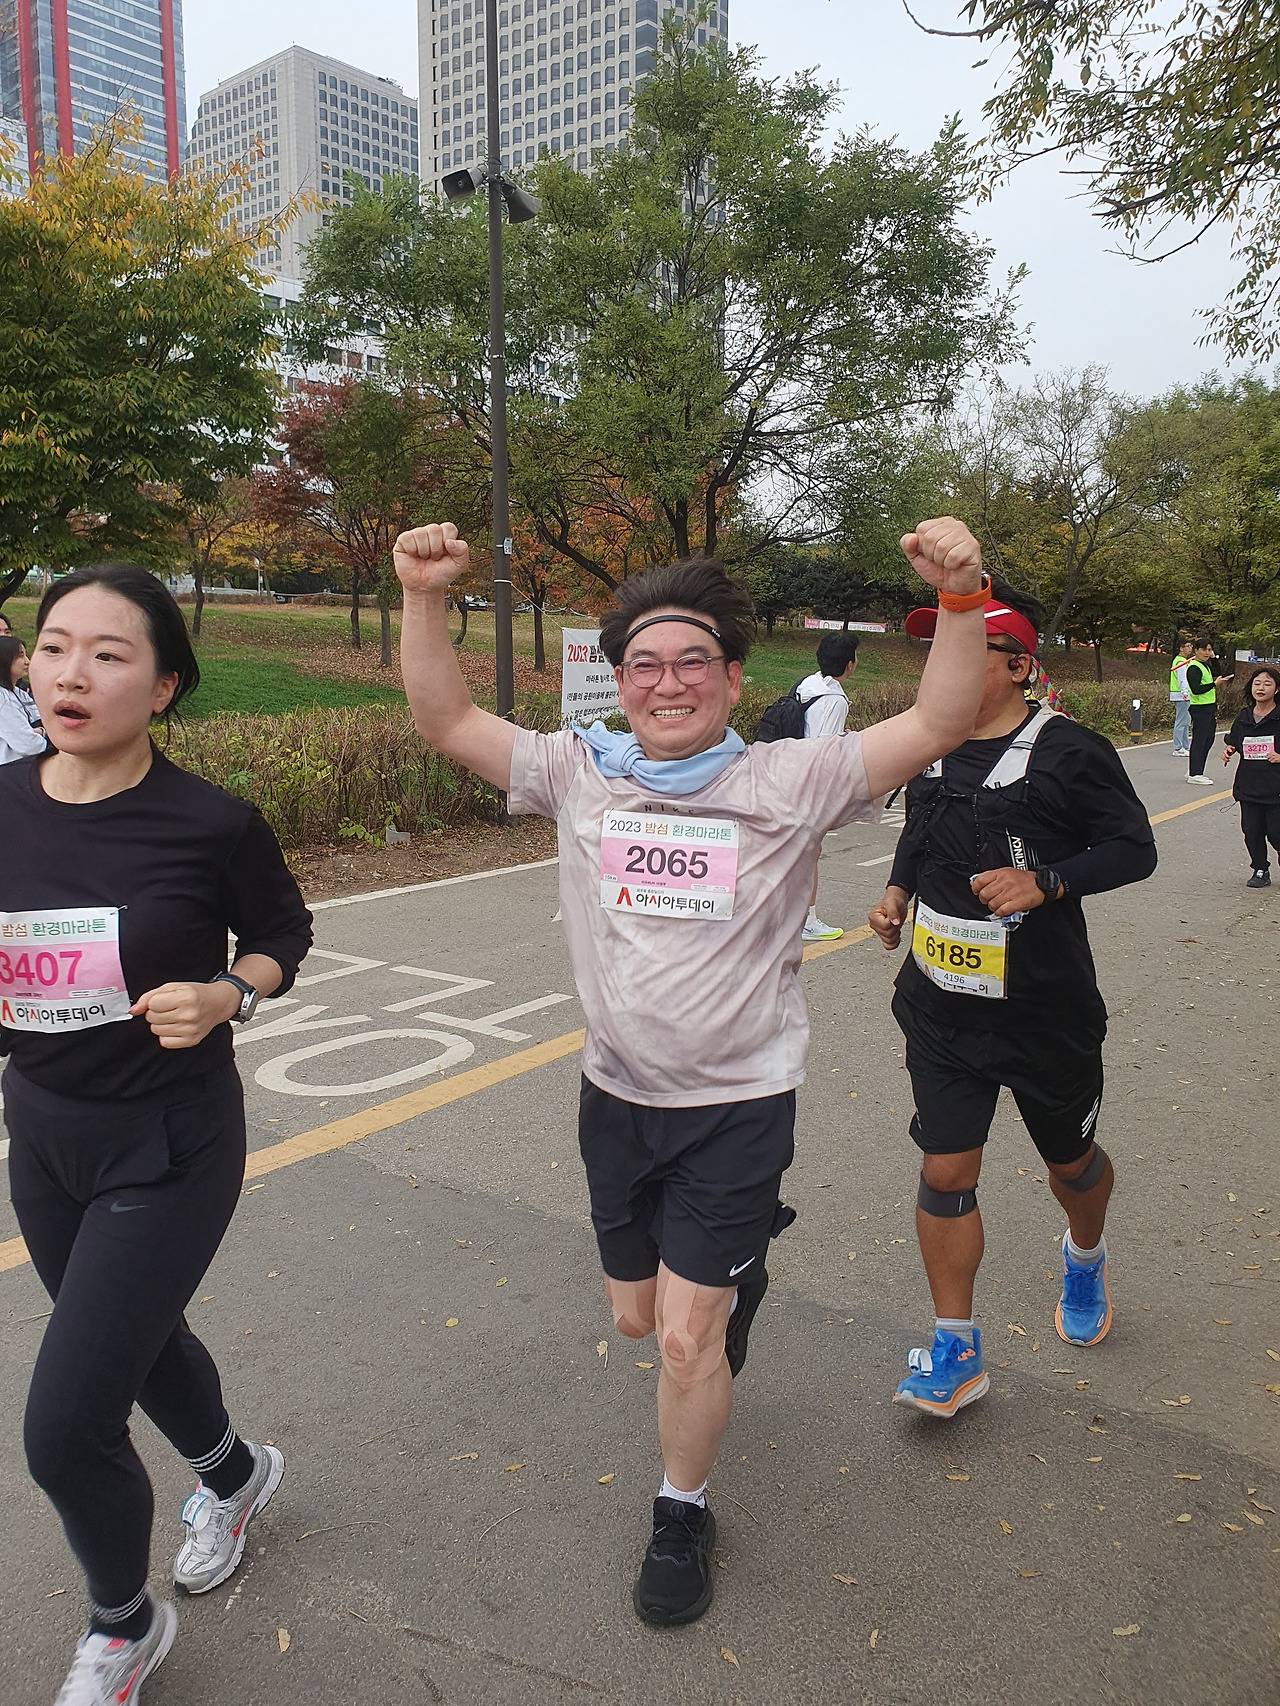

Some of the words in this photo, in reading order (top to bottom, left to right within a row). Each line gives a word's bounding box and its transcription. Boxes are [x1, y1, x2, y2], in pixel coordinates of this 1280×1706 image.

[567, 643, 588, 662] 2023
[1247, 744, 1268, 752] 3270
[609, 819, 642, 833] 2023
[644, 822, 669, 836] 밤섬
[672, 824, 732, 841] 환경마라톤
[624, 845, 709, 879] 2065
[635, 893, 715, 913] 아시아투데이
[2, 923, 28, 938] 밤섬
[31, 918, 107, 937] 환경마라톤
[933, 922, 949, 934] 밤섬
[951, 926, 1000, 941] 환경마라톤
[926, 935, 982, 969] 6185
[0, 950, 83, 987] 3407
[943, 973, 965, 984] 4196
[16, 1004, 106, 1025] 아시아투데이
